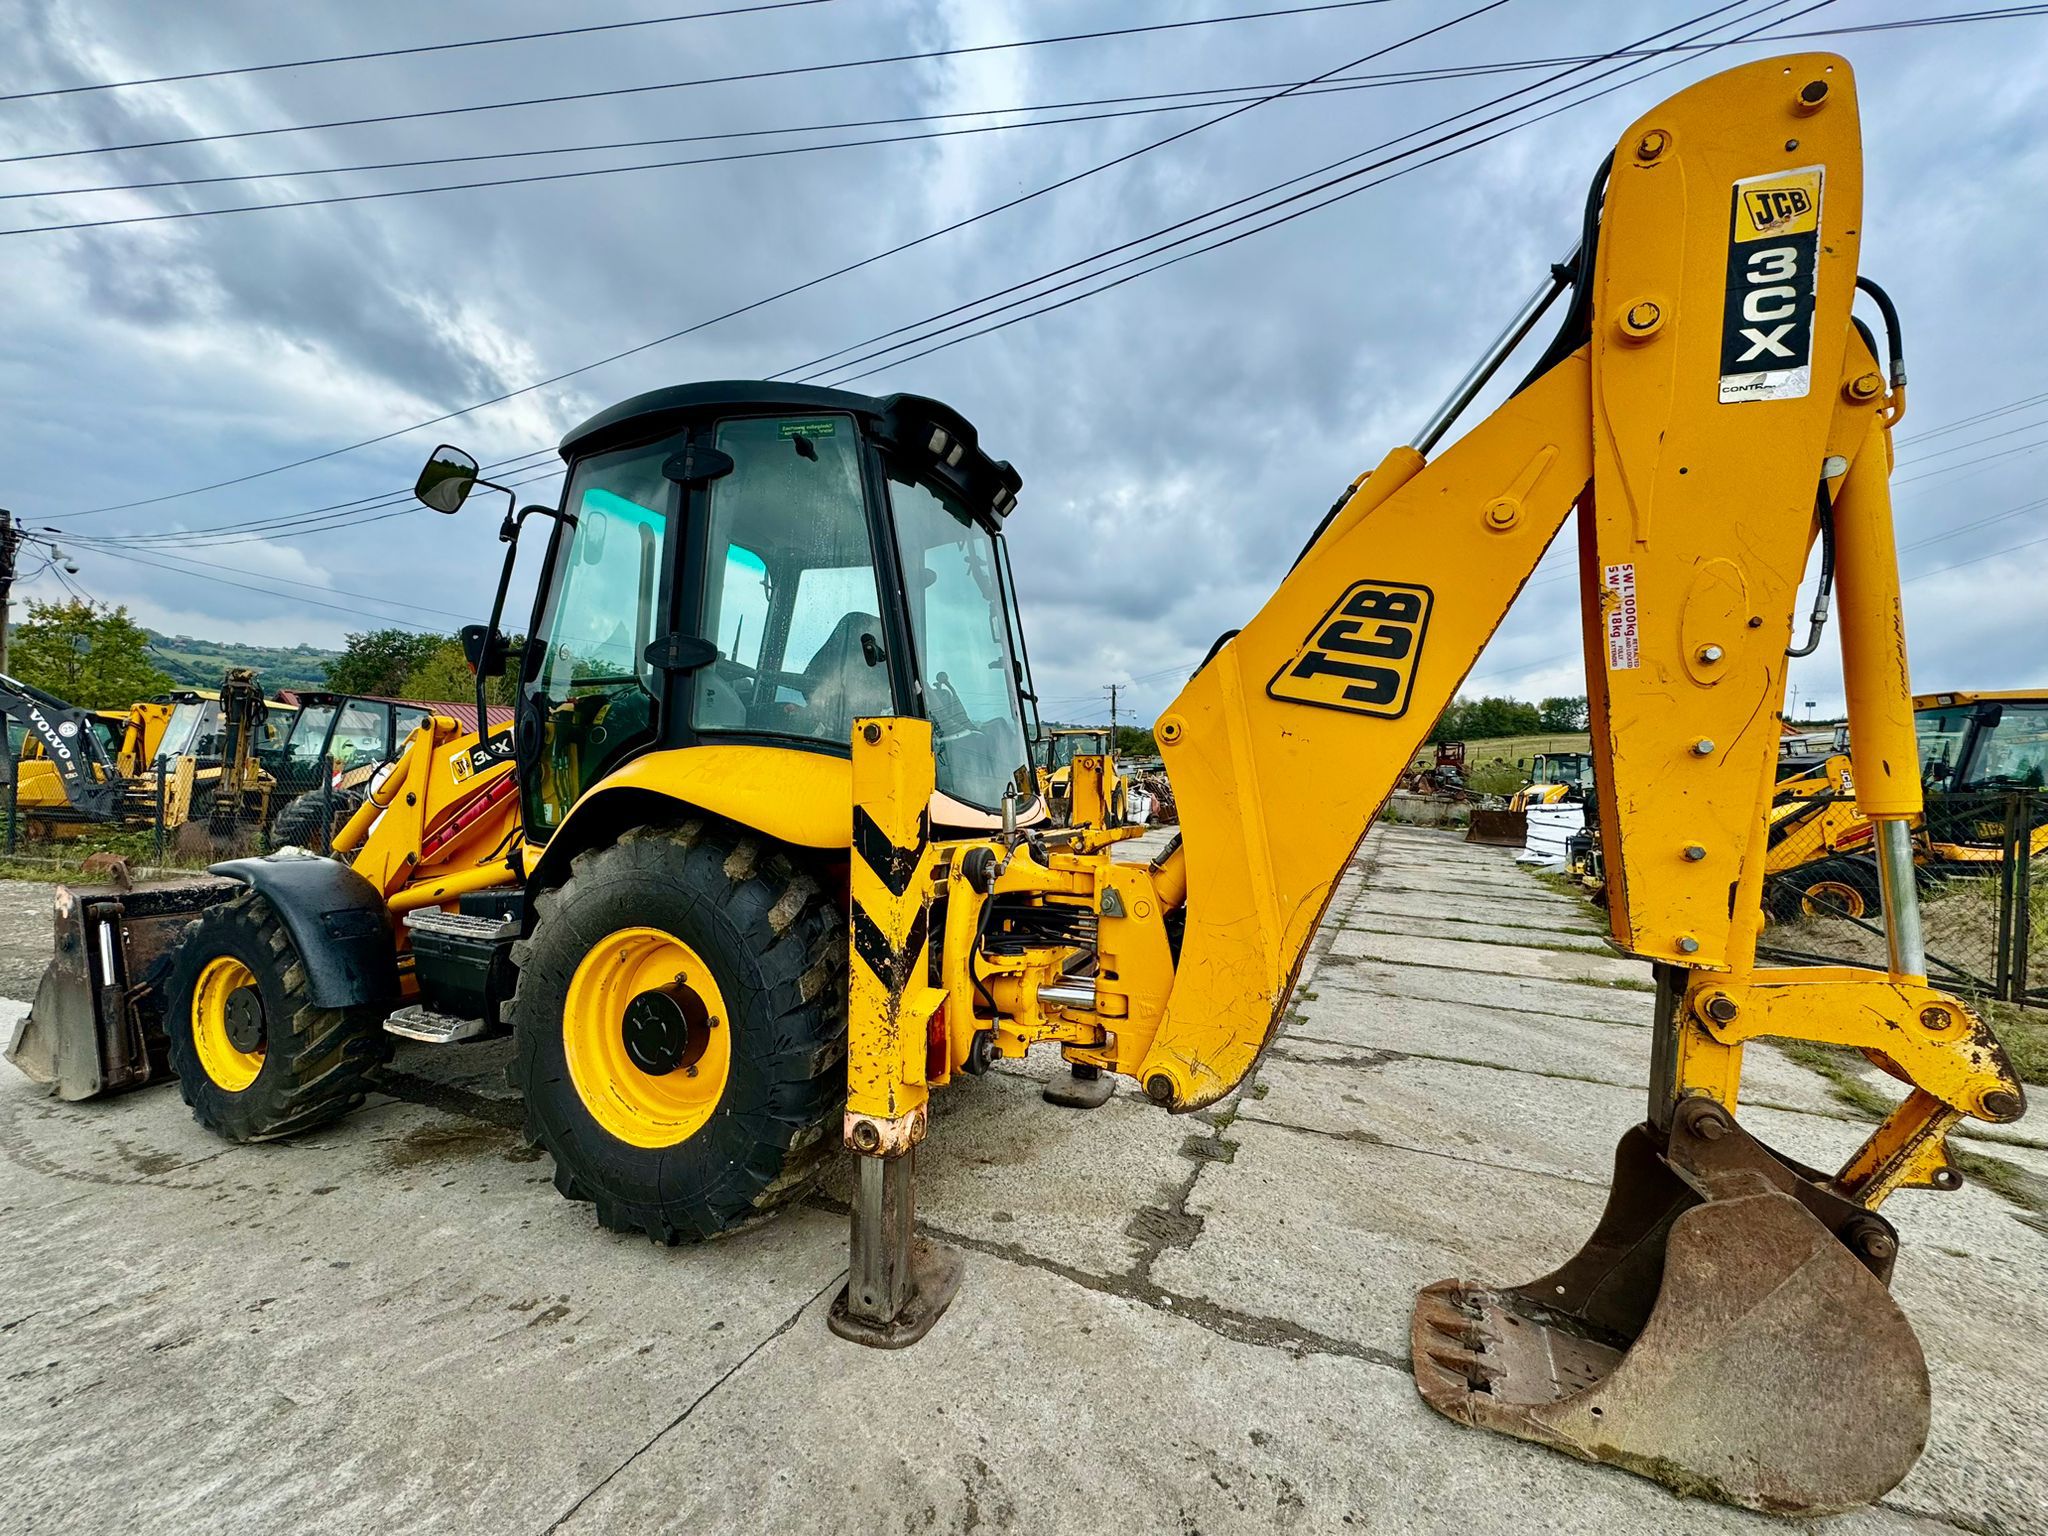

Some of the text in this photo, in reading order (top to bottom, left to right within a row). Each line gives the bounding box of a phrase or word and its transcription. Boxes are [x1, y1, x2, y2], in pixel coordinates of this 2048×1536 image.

[1755, 191, 1807, 225] JCB
[1736, 247, 1798, 362] 3CX
[1622, 564, 1636, 636] SWL 1000kg
[1290, 590, 1422, 705] JCB
[30, 708, 71, 759] VOLVO
[1840, 769, 1853, 789] JCB
